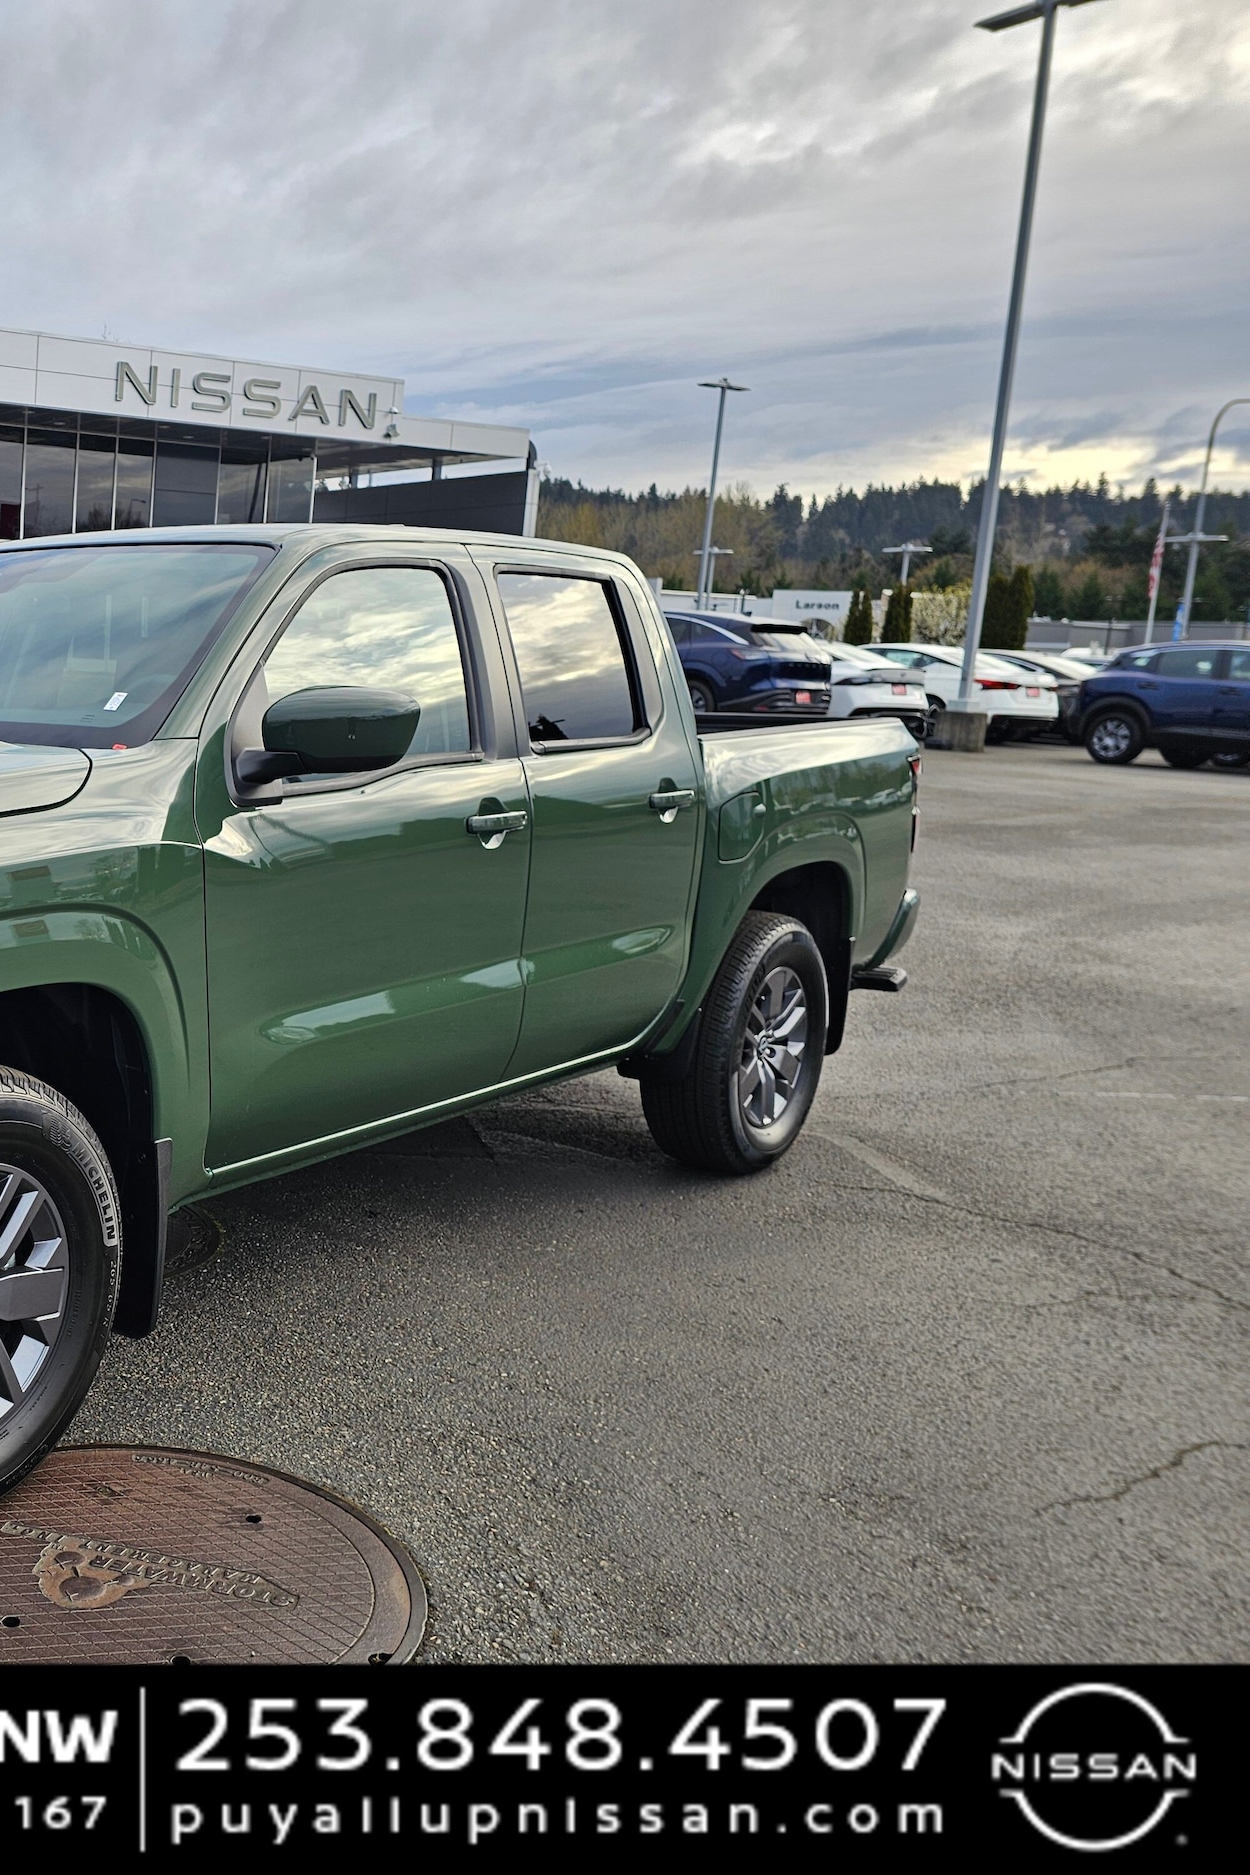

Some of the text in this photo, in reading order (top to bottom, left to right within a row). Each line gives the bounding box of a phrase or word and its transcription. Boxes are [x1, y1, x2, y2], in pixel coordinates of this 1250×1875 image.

[115, 361, 377, 429] NISSAN
[795, 600, 840, 610] Larson
[72, 1140, 116, 1241] MICHELIN
